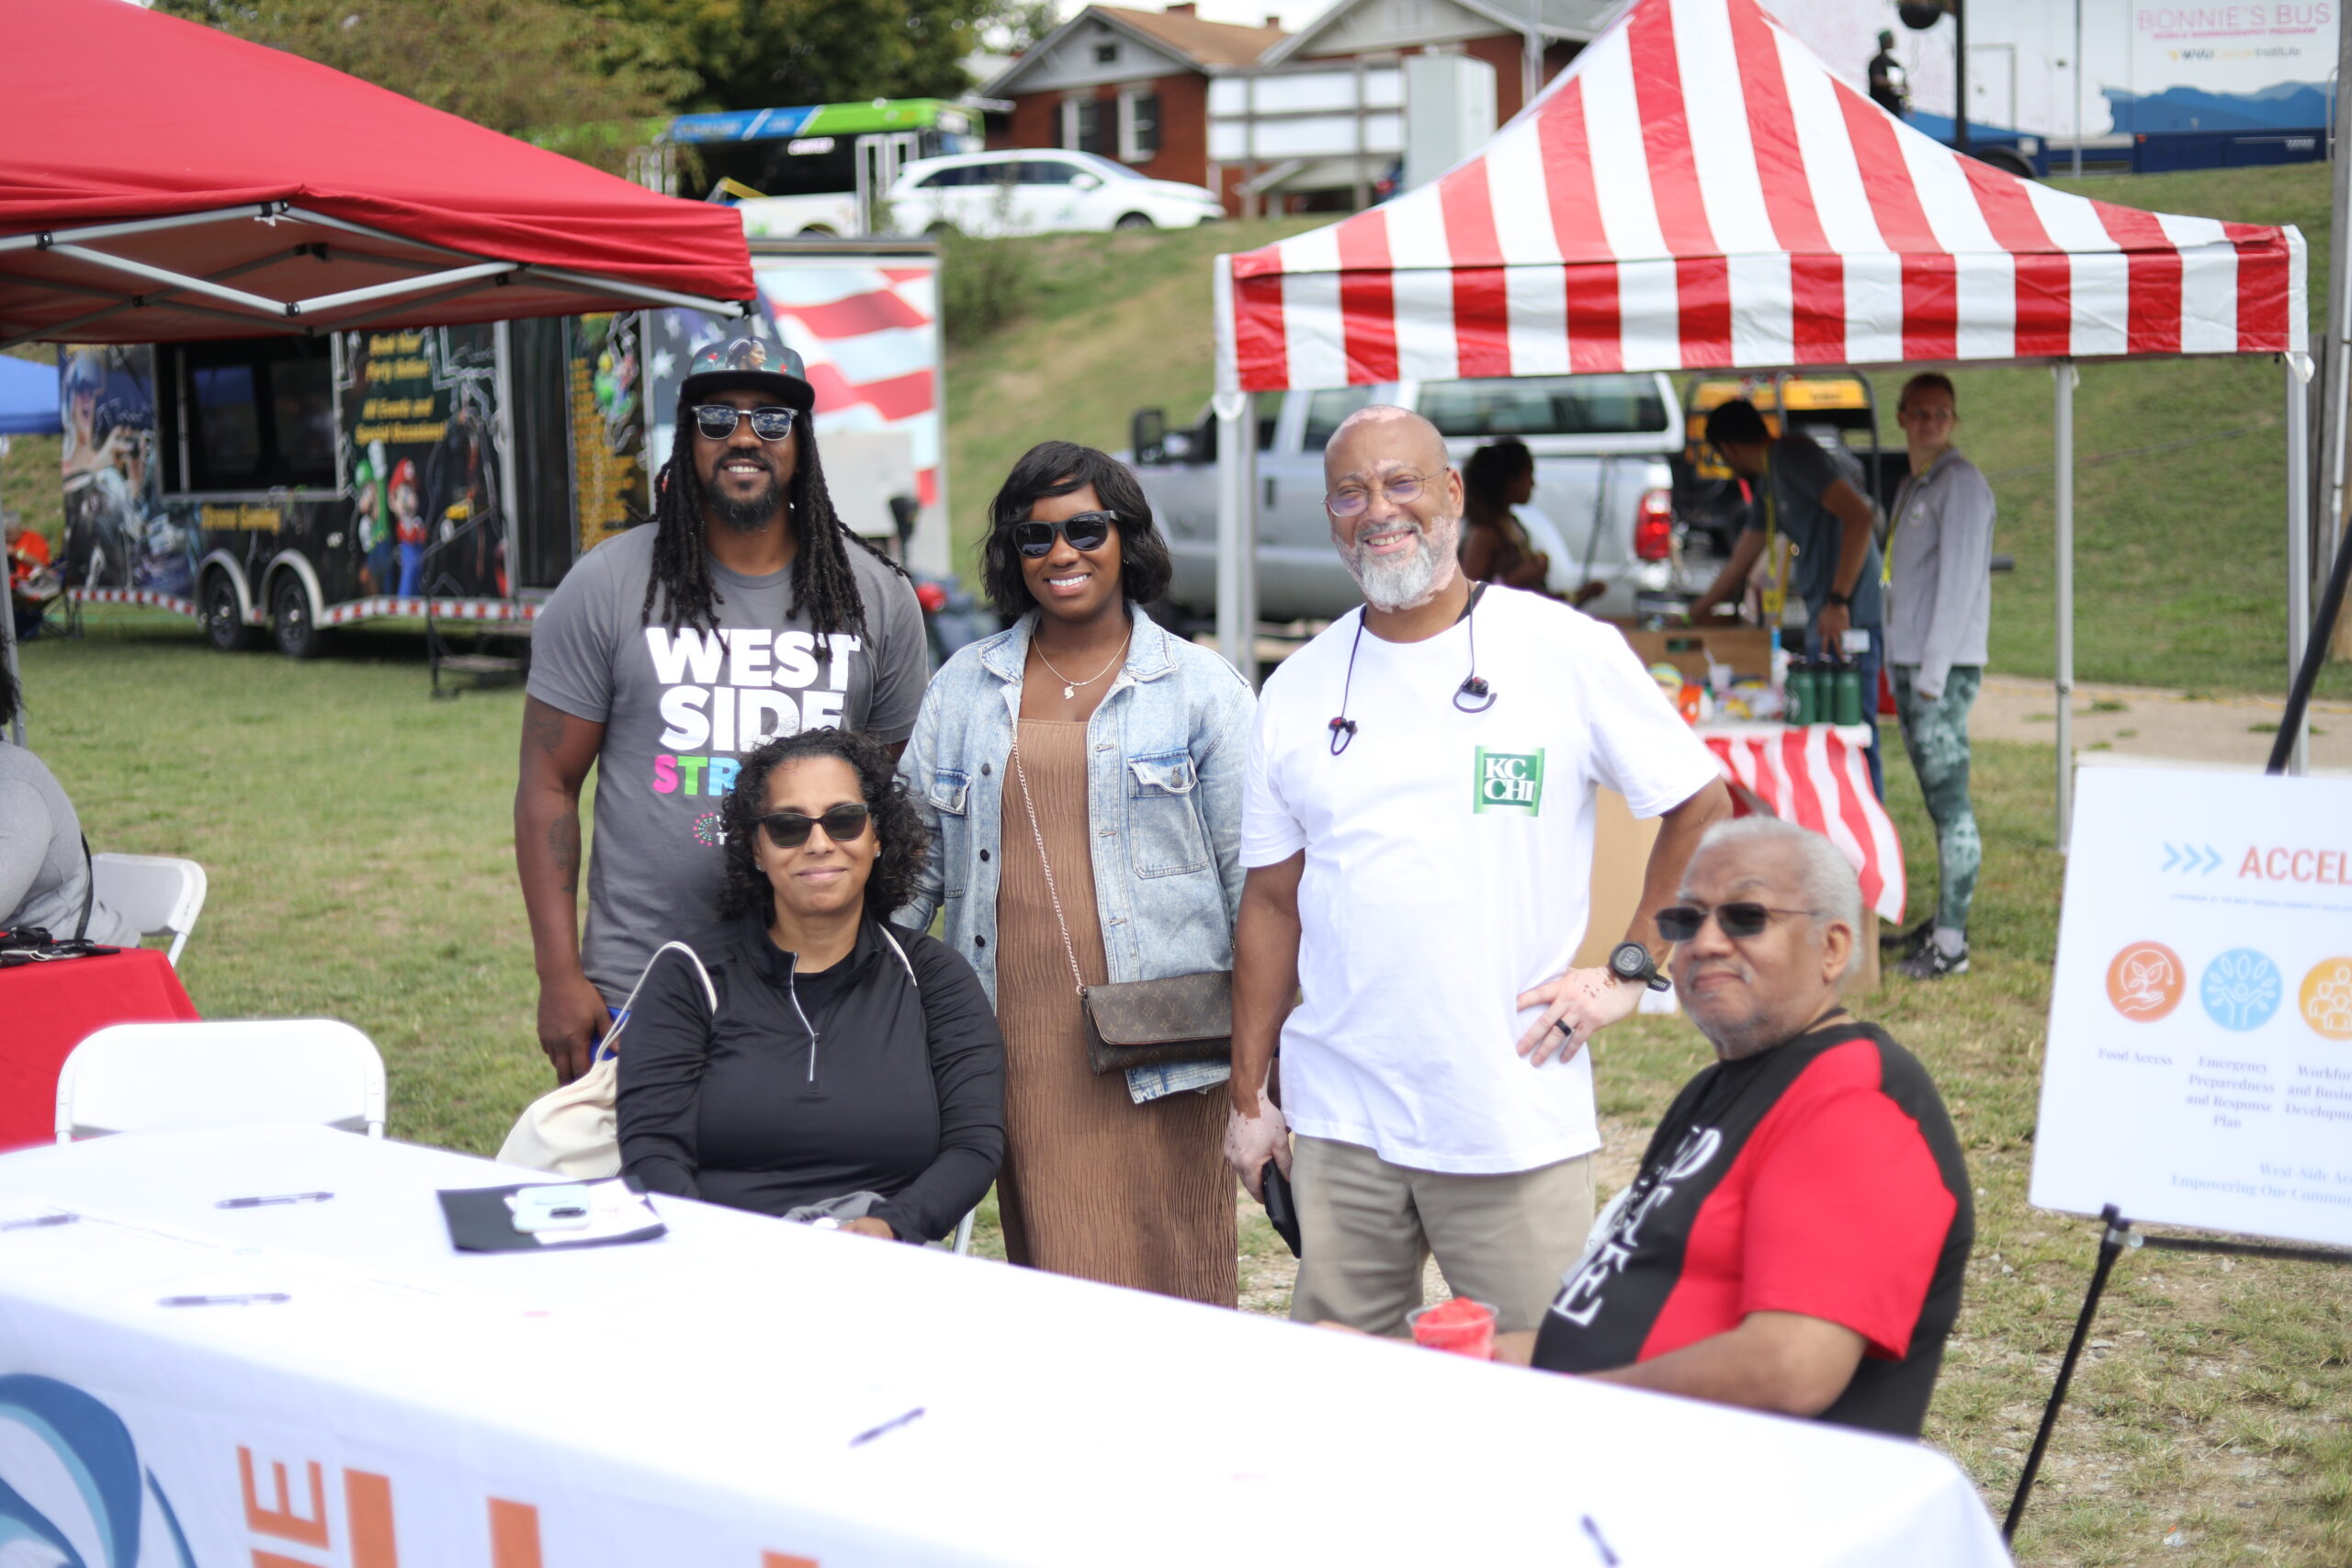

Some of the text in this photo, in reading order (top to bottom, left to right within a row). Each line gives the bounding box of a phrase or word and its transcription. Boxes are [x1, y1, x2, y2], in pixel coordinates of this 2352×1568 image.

[2137, 3, 2331, 30] BONNIE'S BUS
[646, 626, 861, 691] WEST
[659, 684, 846, 752] SIDE
[1484, 757, 1527, 780] KC
[1483, 778, 1536, 802] CHI
[2238, 845, 2352, 886] ACCEL
[2098, 1048, 2173, 1066] Food Access
[2199, 1056, 2267, 1074] Emergency
[2188, 1074, 2275, 1094] Preparedness
[2287, 1085, 2312, 1097] and
[2187, 1094, 2273, 1112] and Response
[2213, 1114, 2242, 1129] Plan
[2171, 1174, 2256, 1197] Empowering
[2261, 1184, 2286, 1199] Our
